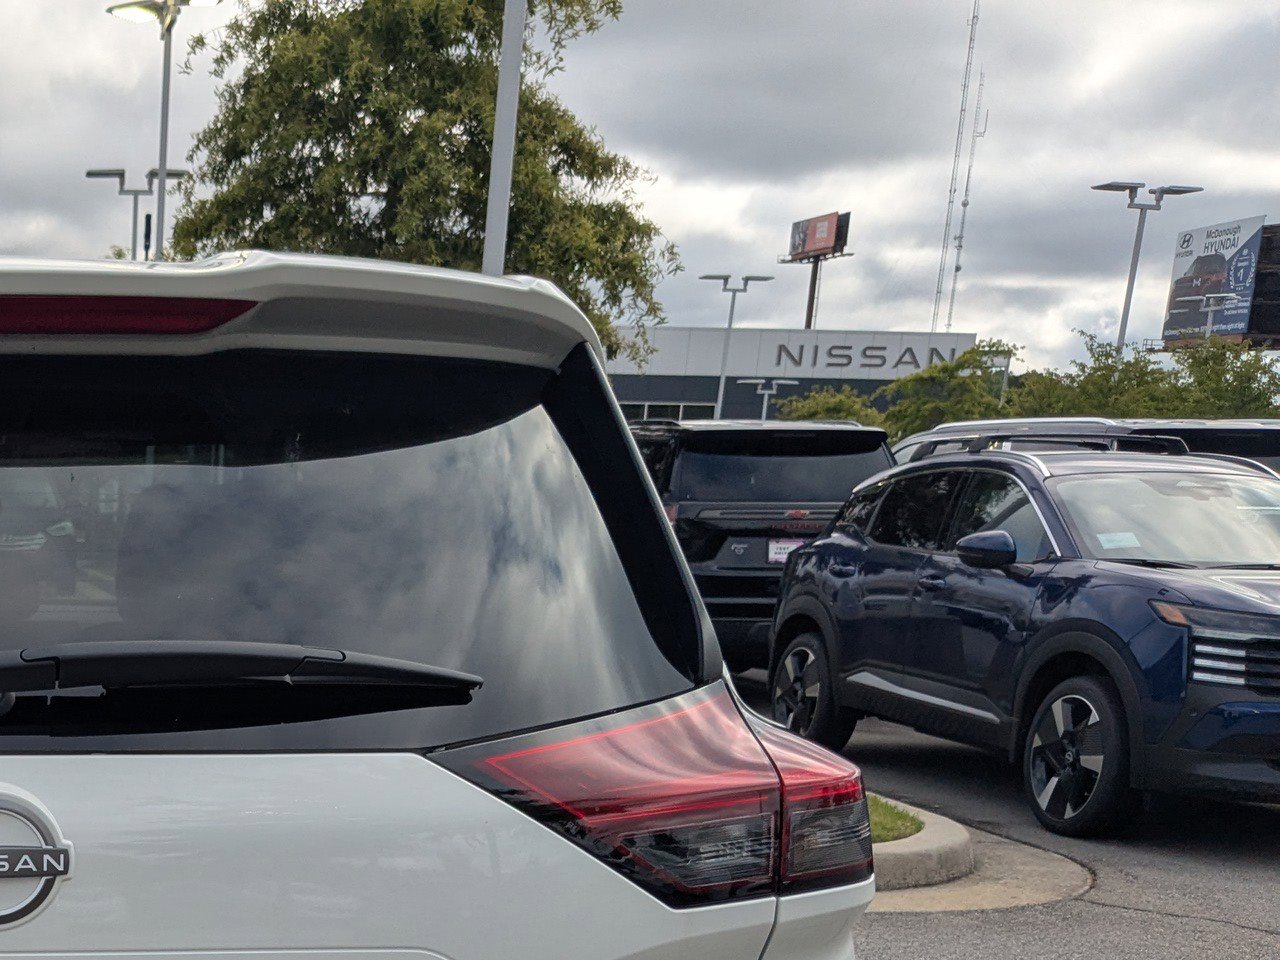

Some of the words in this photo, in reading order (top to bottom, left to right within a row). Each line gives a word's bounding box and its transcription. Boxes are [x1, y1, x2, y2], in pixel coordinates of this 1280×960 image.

[1206, 225, 1241, 239] McDonough
[1203, 237, 1240, 253] HYUNDAI
[775, 344, 956, 369] NISSAN
